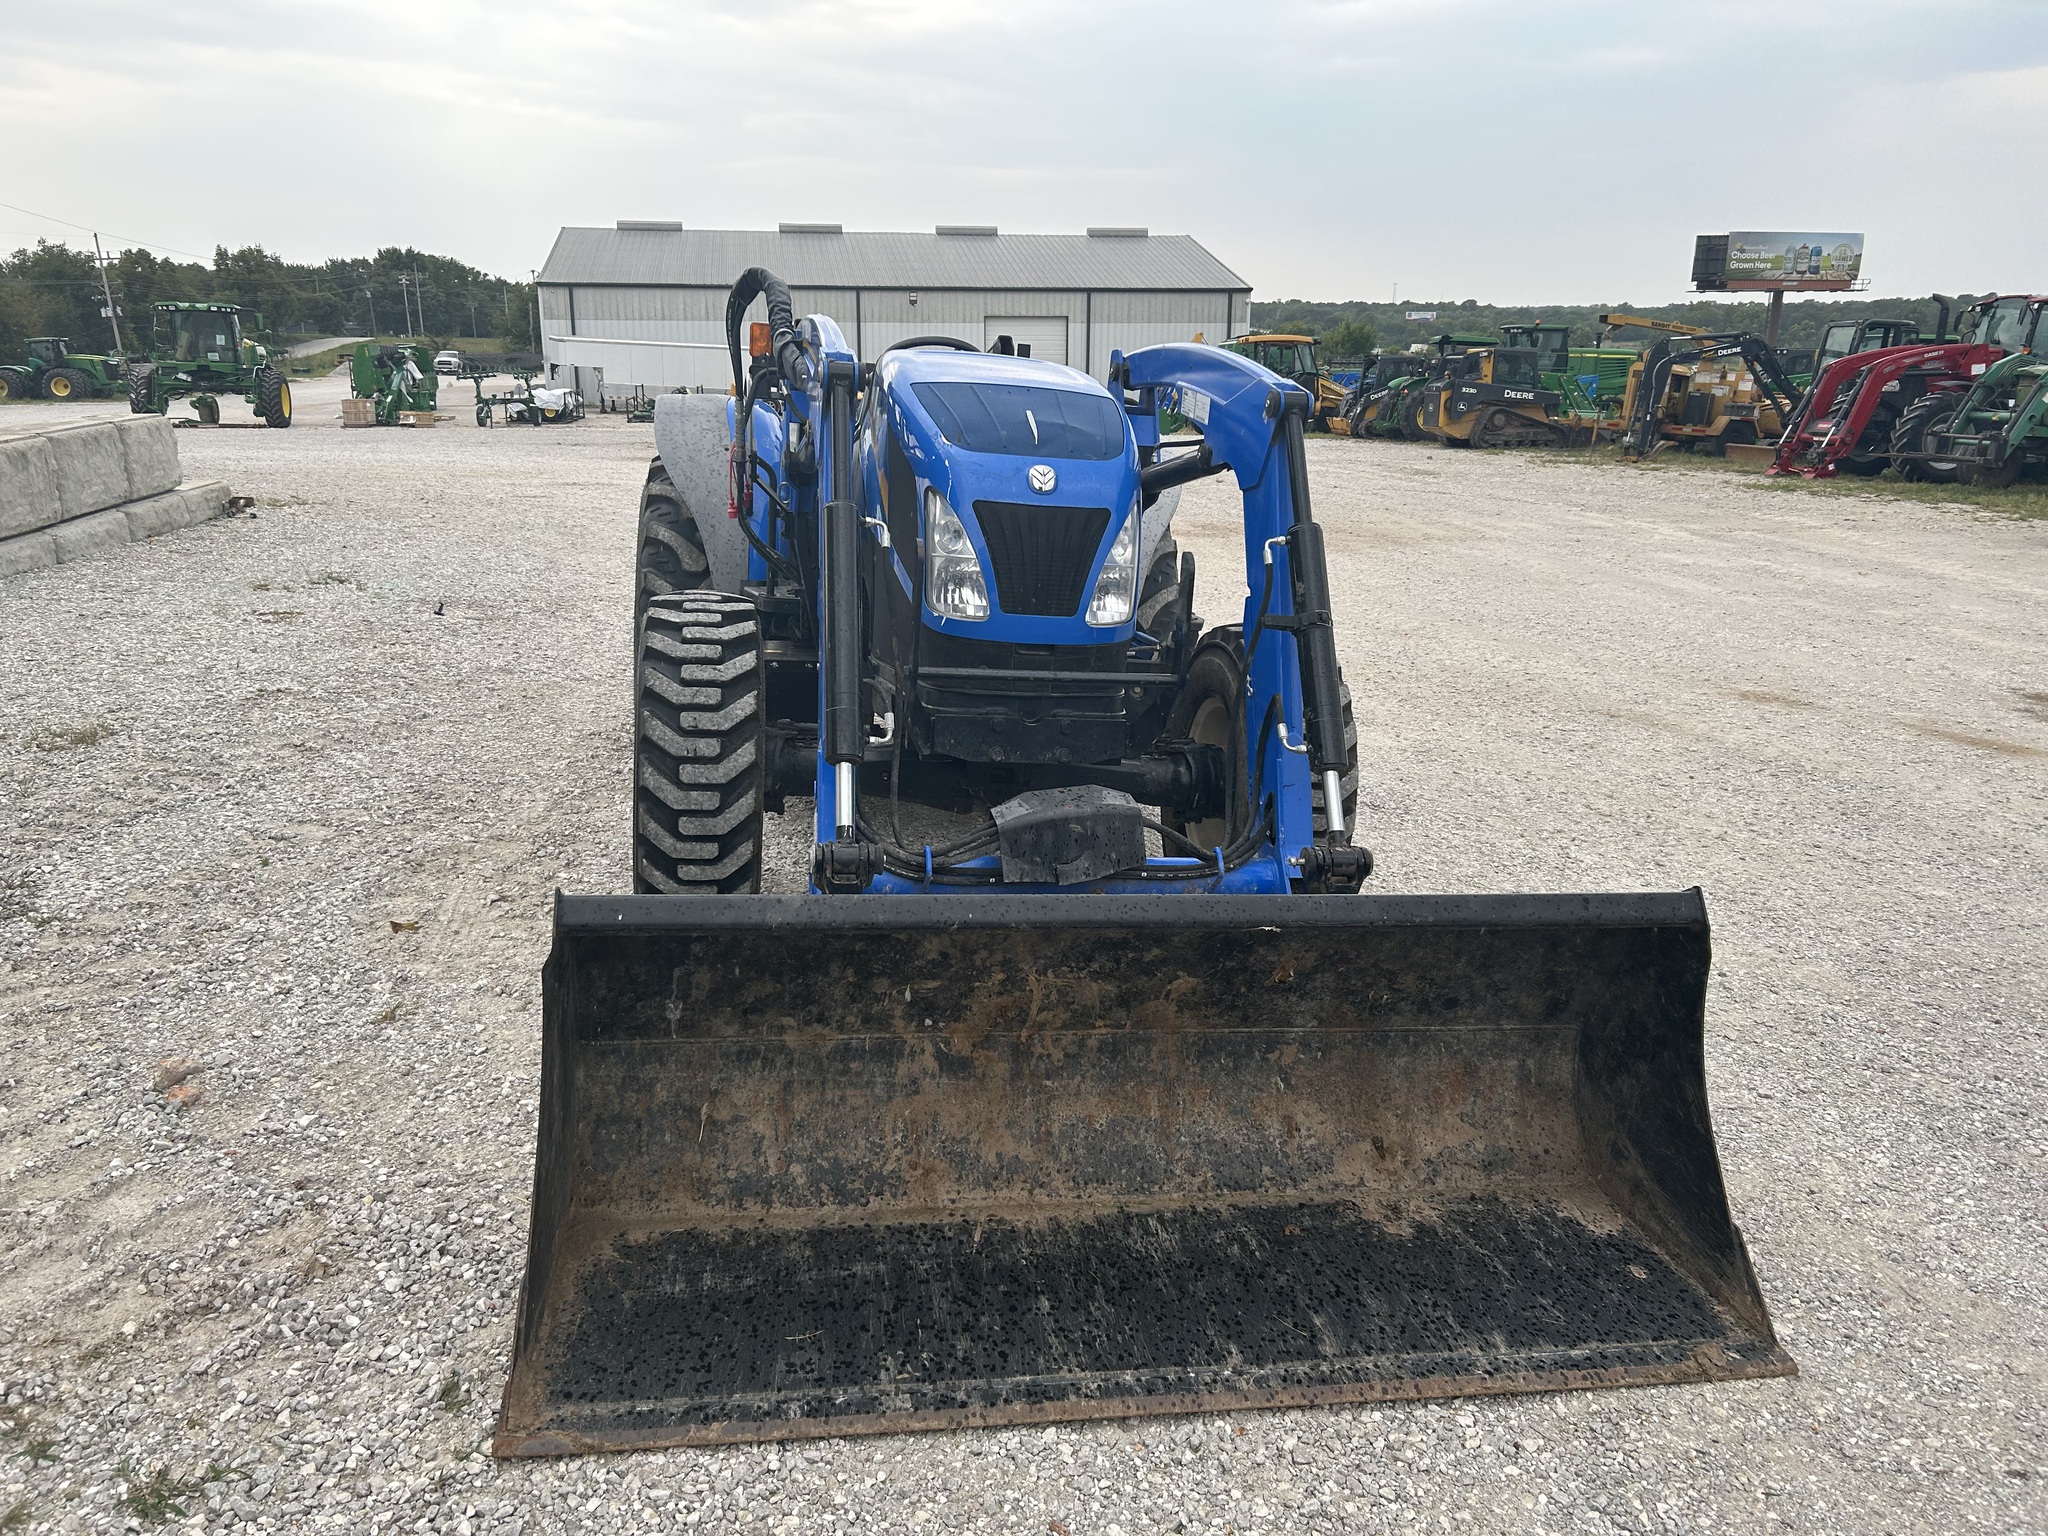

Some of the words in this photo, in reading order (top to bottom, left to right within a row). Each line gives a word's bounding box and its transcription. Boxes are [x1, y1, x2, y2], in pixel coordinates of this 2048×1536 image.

[1731, 250, 1759, 259] Choose
[1760, 251, 1776, 259] Beer
[1730, 260, 1754, 269] Grown
[1754, 261, 1772, 269] Here
[1651, 321, 1671, 329] BANDIT
[1717, 346, 1742, 356] DEERE
[1504, 389, 1534, 399] DEERE
